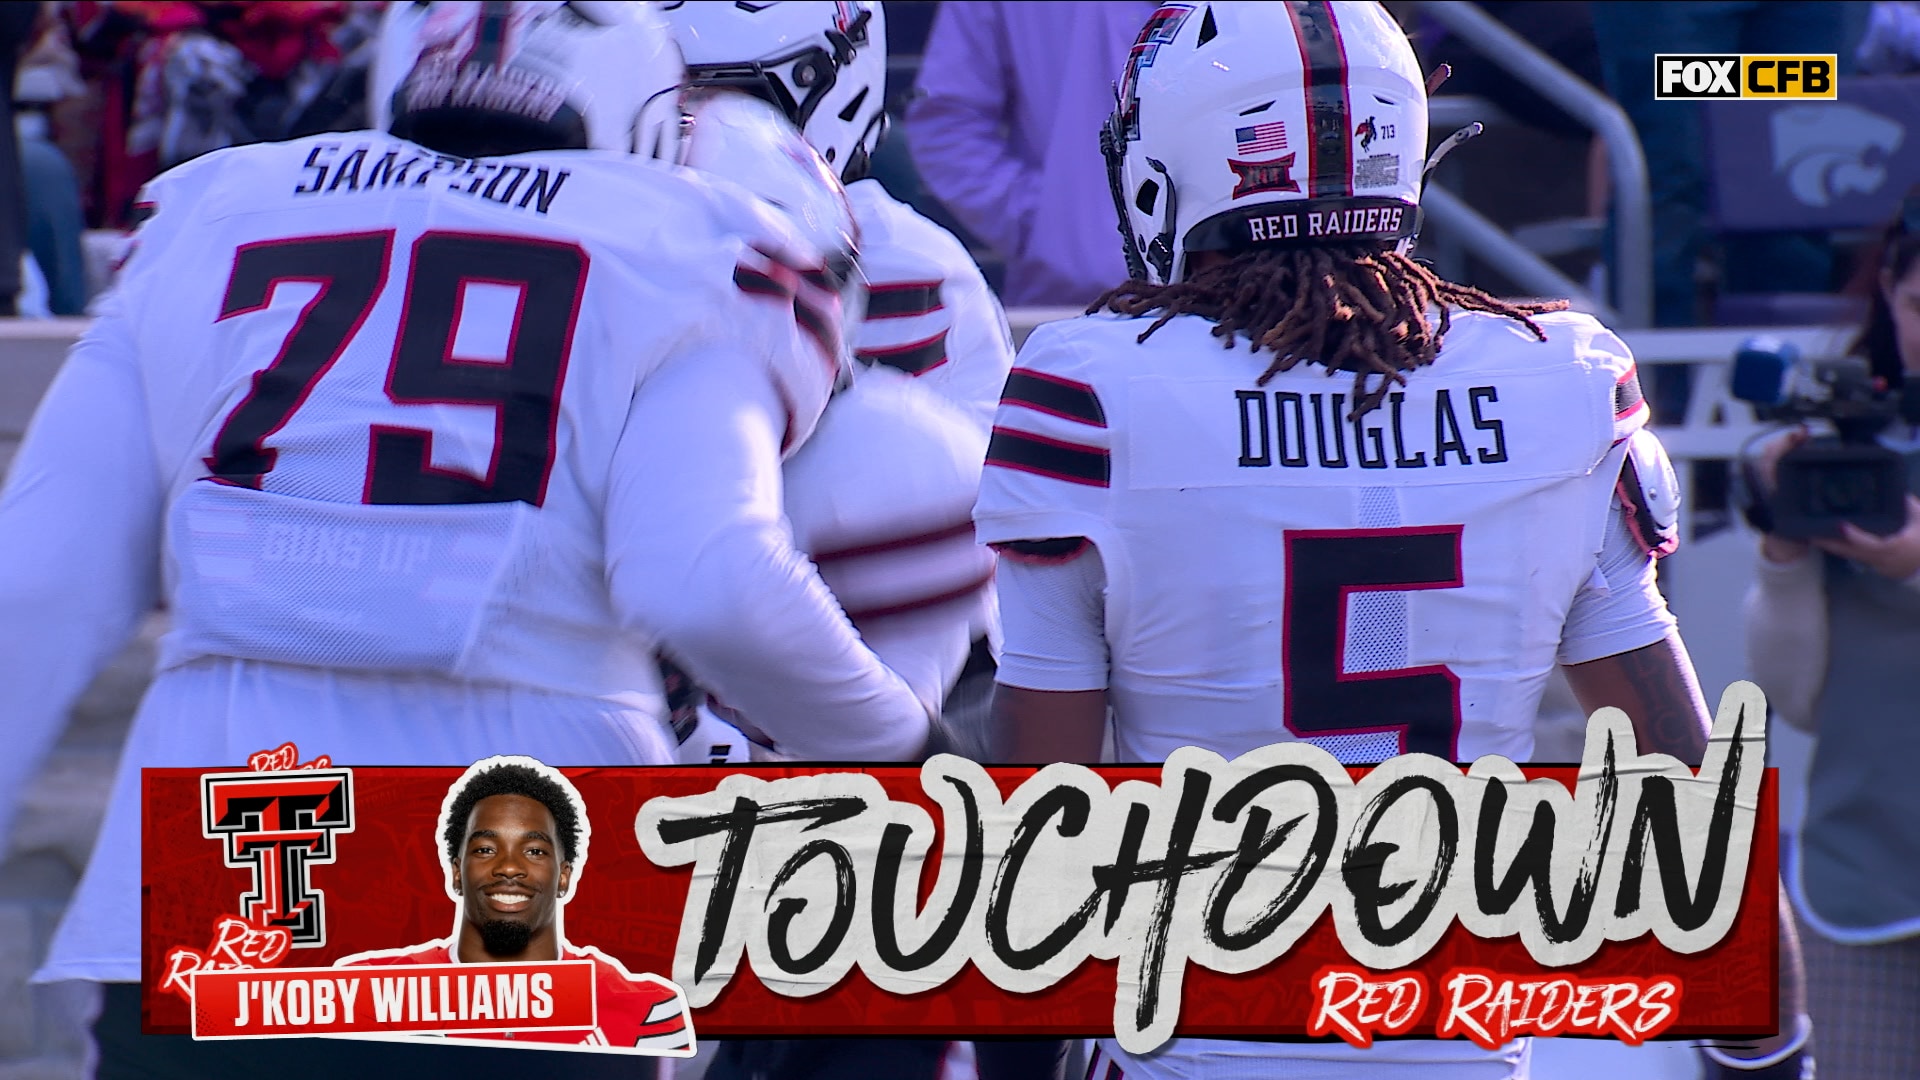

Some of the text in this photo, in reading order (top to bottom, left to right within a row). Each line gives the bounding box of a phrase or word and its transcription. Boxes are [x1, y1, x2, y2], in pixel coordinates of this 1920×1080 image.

[1380, 124, 1396, 140] 713
[294, 141, 571, 214] SAMPSON
[1249, 207, 1404, 242] RED RAIDERS
[199, 228, 591, 507] 79
[1235, 386, 1508, 469] DOUGLAS
[261, 521, 432, 574] GUNS UP
[1281, 524, 1464, 764] 5
